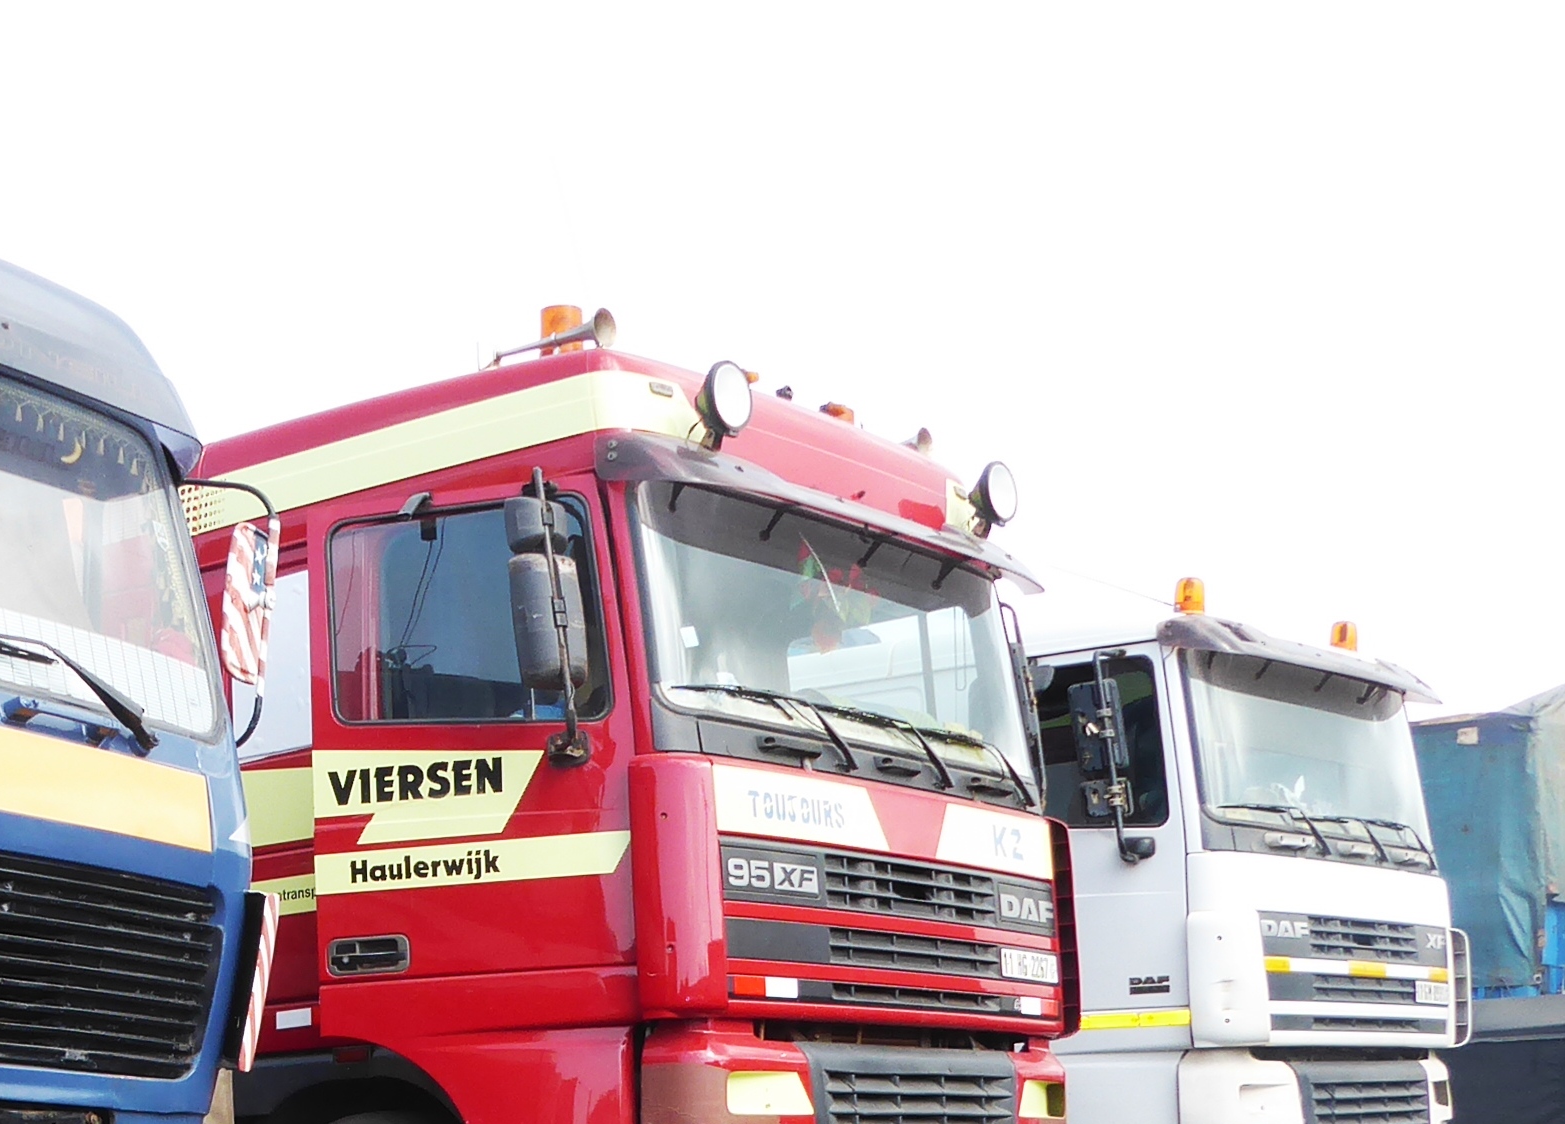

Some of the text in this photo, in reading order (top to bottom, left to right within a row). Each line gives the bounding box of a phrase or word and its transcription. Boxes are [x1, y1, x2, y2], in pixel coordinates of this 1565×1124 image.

[327, 756, 503, 806] VIERSEN
[748, 790, 845, 829] TOUJOURS
[349, 849, 501, 884] Haulerwijk
[999, 893, 1054, 924] DAF
[1260, 918, 1310, 940] DAF
[1129, 975, 1171, 986] DAF
